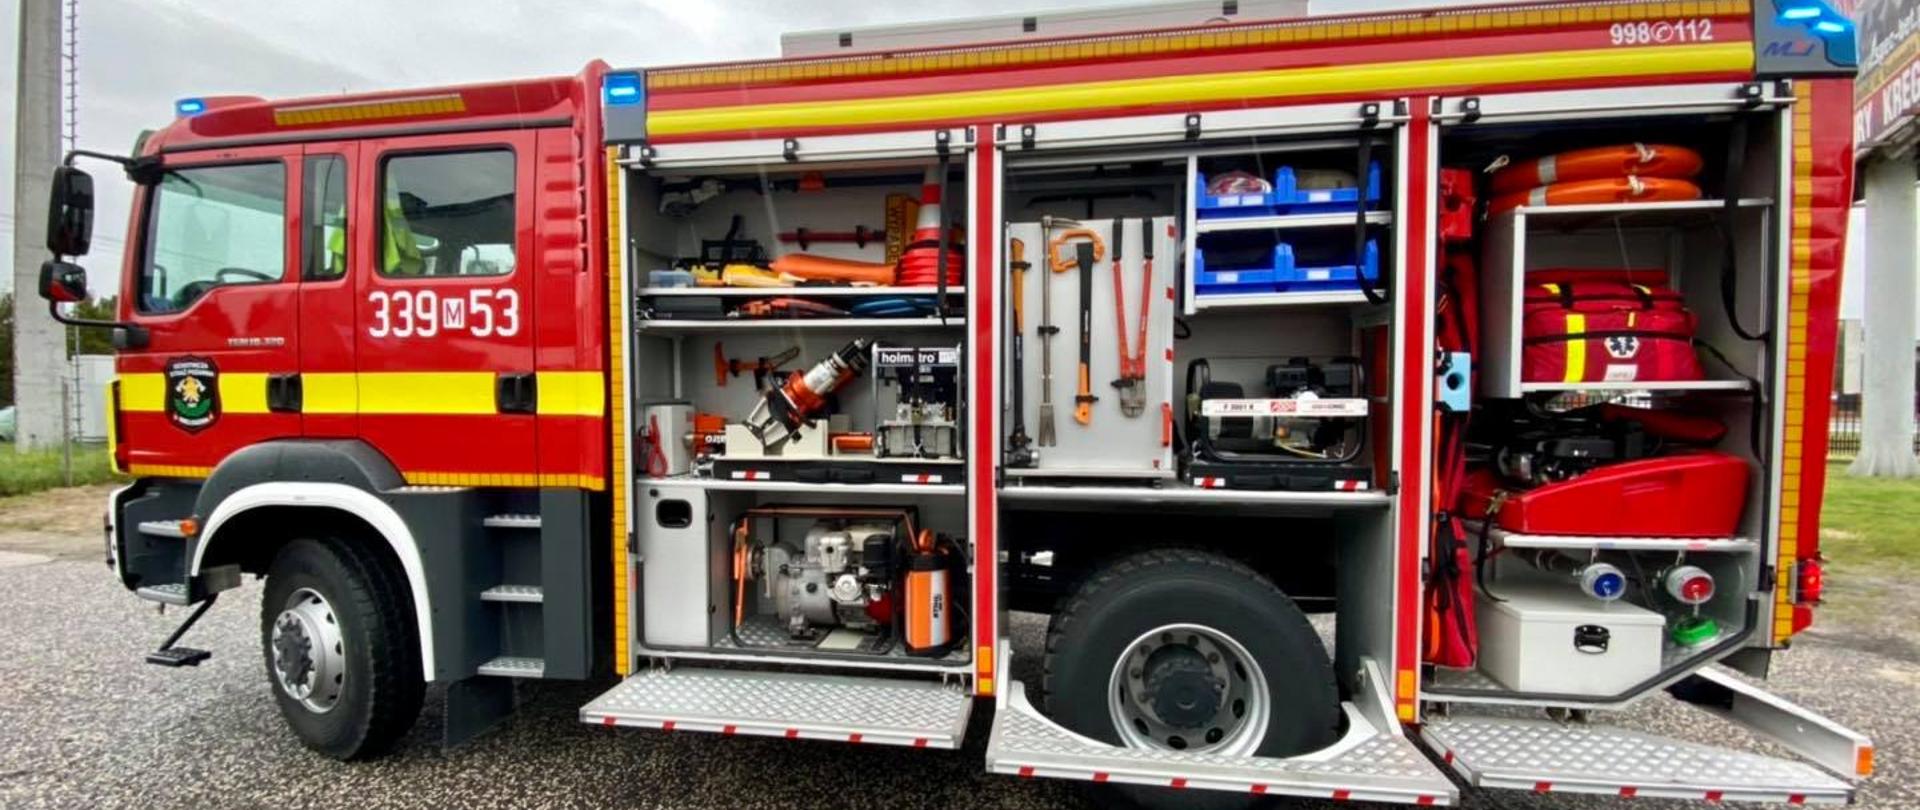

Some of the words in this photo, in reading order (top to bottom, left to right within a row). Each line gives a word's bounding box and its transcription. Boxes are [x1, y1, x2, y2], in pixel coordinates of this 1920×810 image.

[1610, 23, 1650, 45] 998
[1674, 19, 1713, 42] 112
[368, 289, 437, 338] 339
[445, 300, 462, 326] M
[469, 287, 519, 337] 53
[881, 351, 935, 364] holmtro
